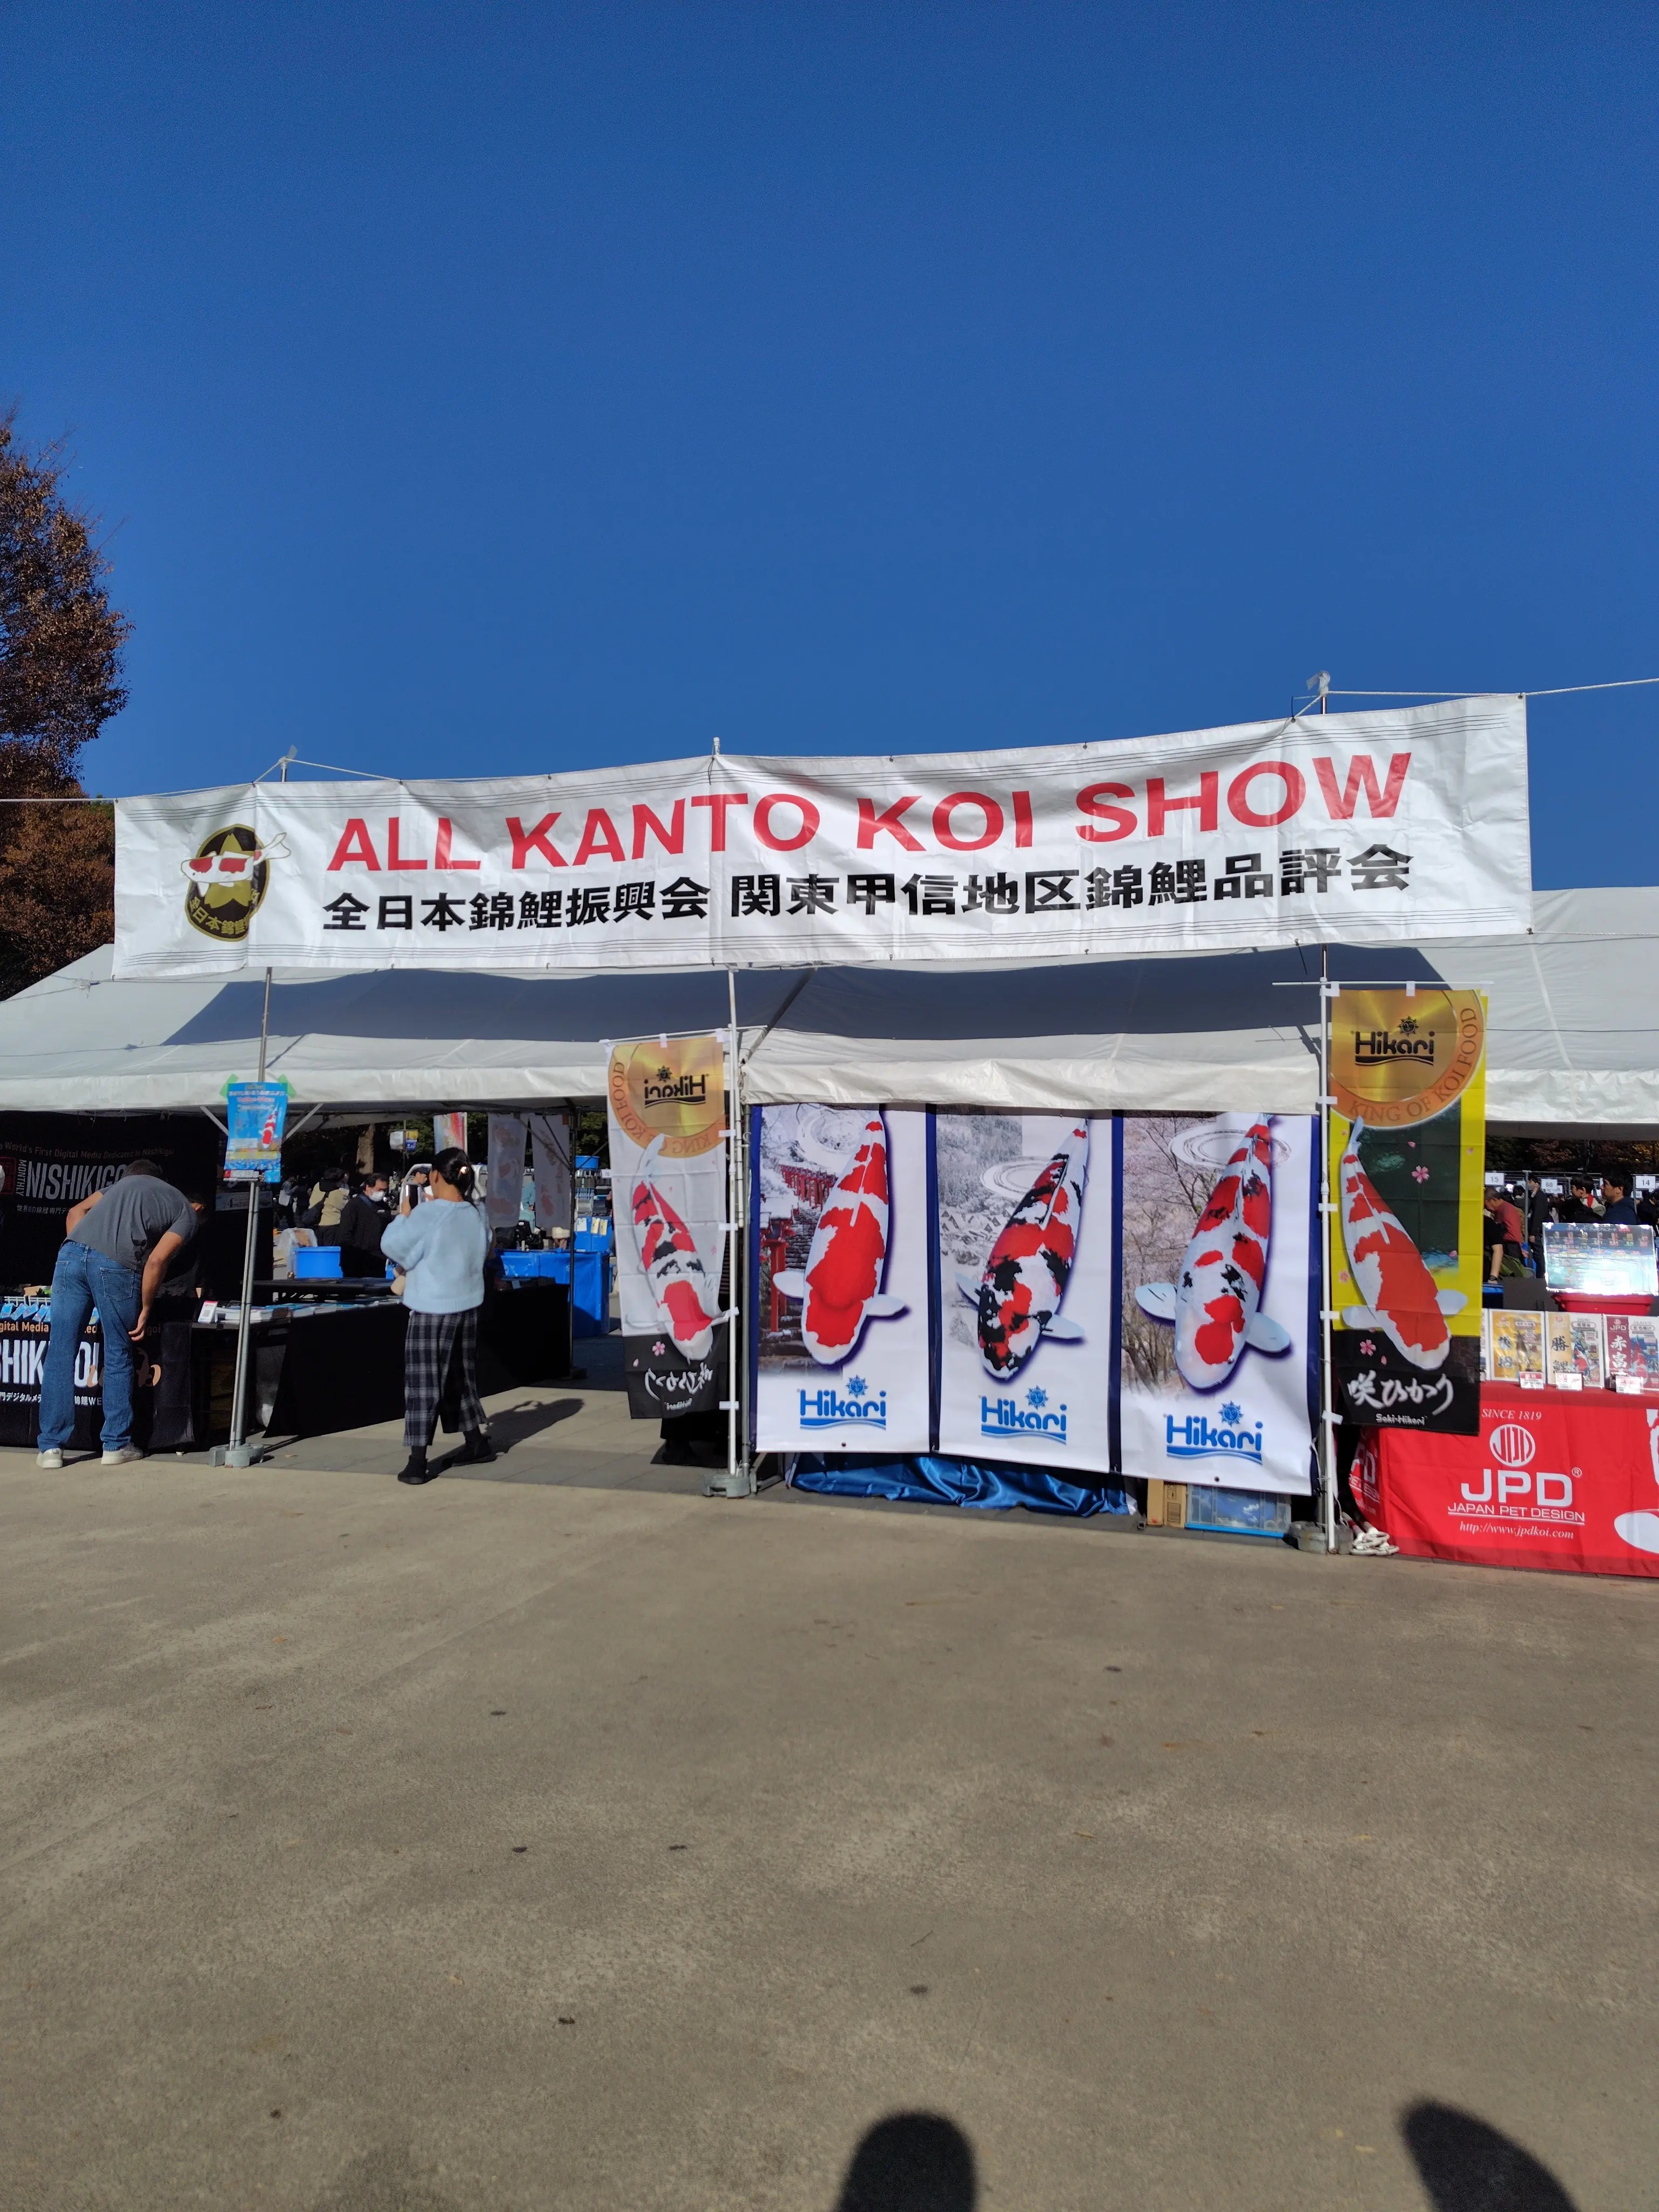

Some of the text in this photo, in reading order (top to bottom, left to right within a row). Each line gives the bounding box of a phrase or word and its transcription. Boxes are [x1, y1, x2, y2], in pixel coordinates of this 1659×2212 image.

[327, 752, 1412, 872] ALL KANTO KOI SHOW
[323, 844, 1414, 932] 全日本錦鯉振興会 関東甲信地区錦鯉品評会
[1355, 1030, 1435, 1055] Hikari
[1348, 1007, 1479, 1122] KING OF KOI FOOD
[15, 1159, 26, 1196] MONTHLY
[22, 1321, 49, 1333] Media
[800, 1389, 887, 1417] Hikari
[981, 1395, 1067, 1431] Hikari
[1481, 1408, 1542, 1421] SINCE 1819
[1166, 1414, 1263, 1452] Hikari
[1375, 1413, 1425, 1426] Saki-Hikari
[1461, 1468, 1573, 1507] JPD
[1448, 1503, 1585, 1522] JAPAN PET DESIGN
[1460, 1521, 1574, 1540] http://www.jpdkoi.com
